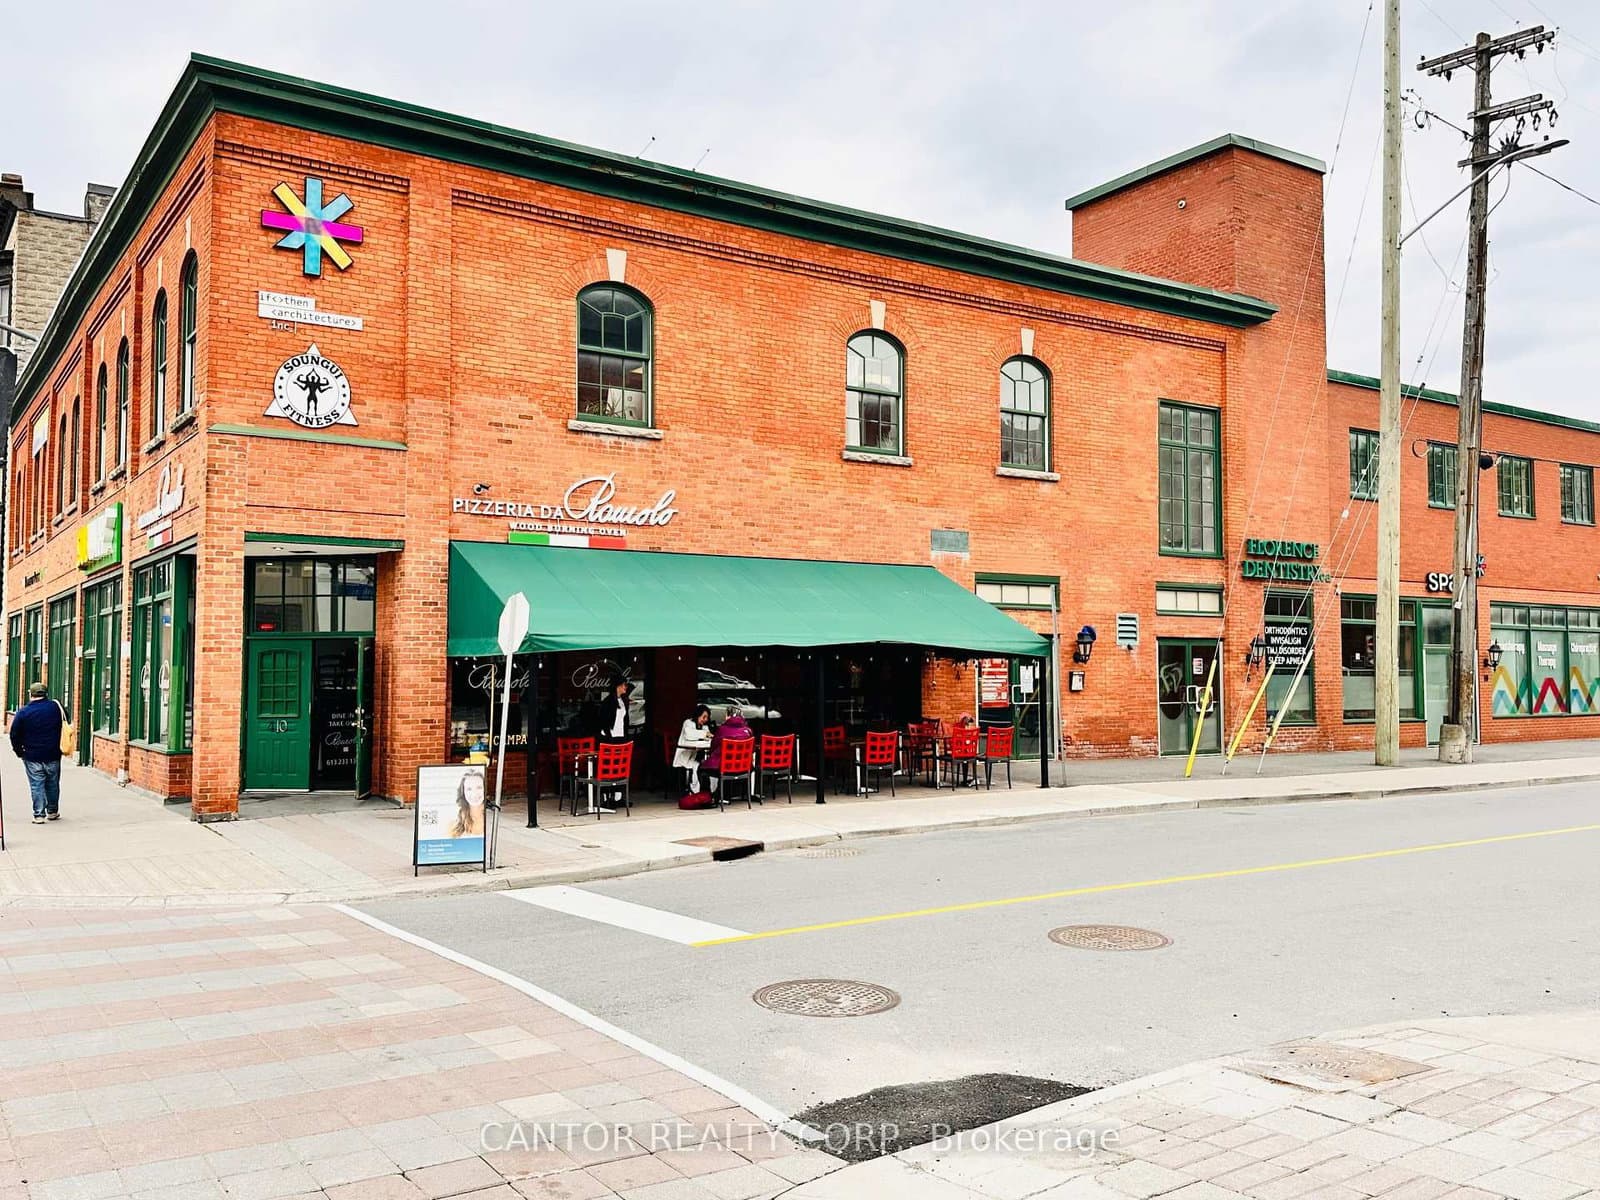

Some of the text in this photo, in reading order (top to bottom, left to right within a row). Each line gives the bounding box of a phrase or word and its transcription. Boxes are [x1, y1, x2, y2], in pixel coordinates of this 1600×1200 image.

[283, 355, 343, 379] SOUNGUI
[283, 403, 340, 426] FITNESS
[453, 498, 535, 518] PIZZERIA
[540, 505, 564, 519] DA
[509, 522, 543, 531] WOOD
[1247, 539, 1319, 559] FLORENCE
[1265, 626, 1308, 636] ORTHODONTICS
[1270, 636, 1302, 645] INVISALIGN
[1266, 646, 1278, 655] TMJ
[1268, 656, 1285, 665] SLEEP
